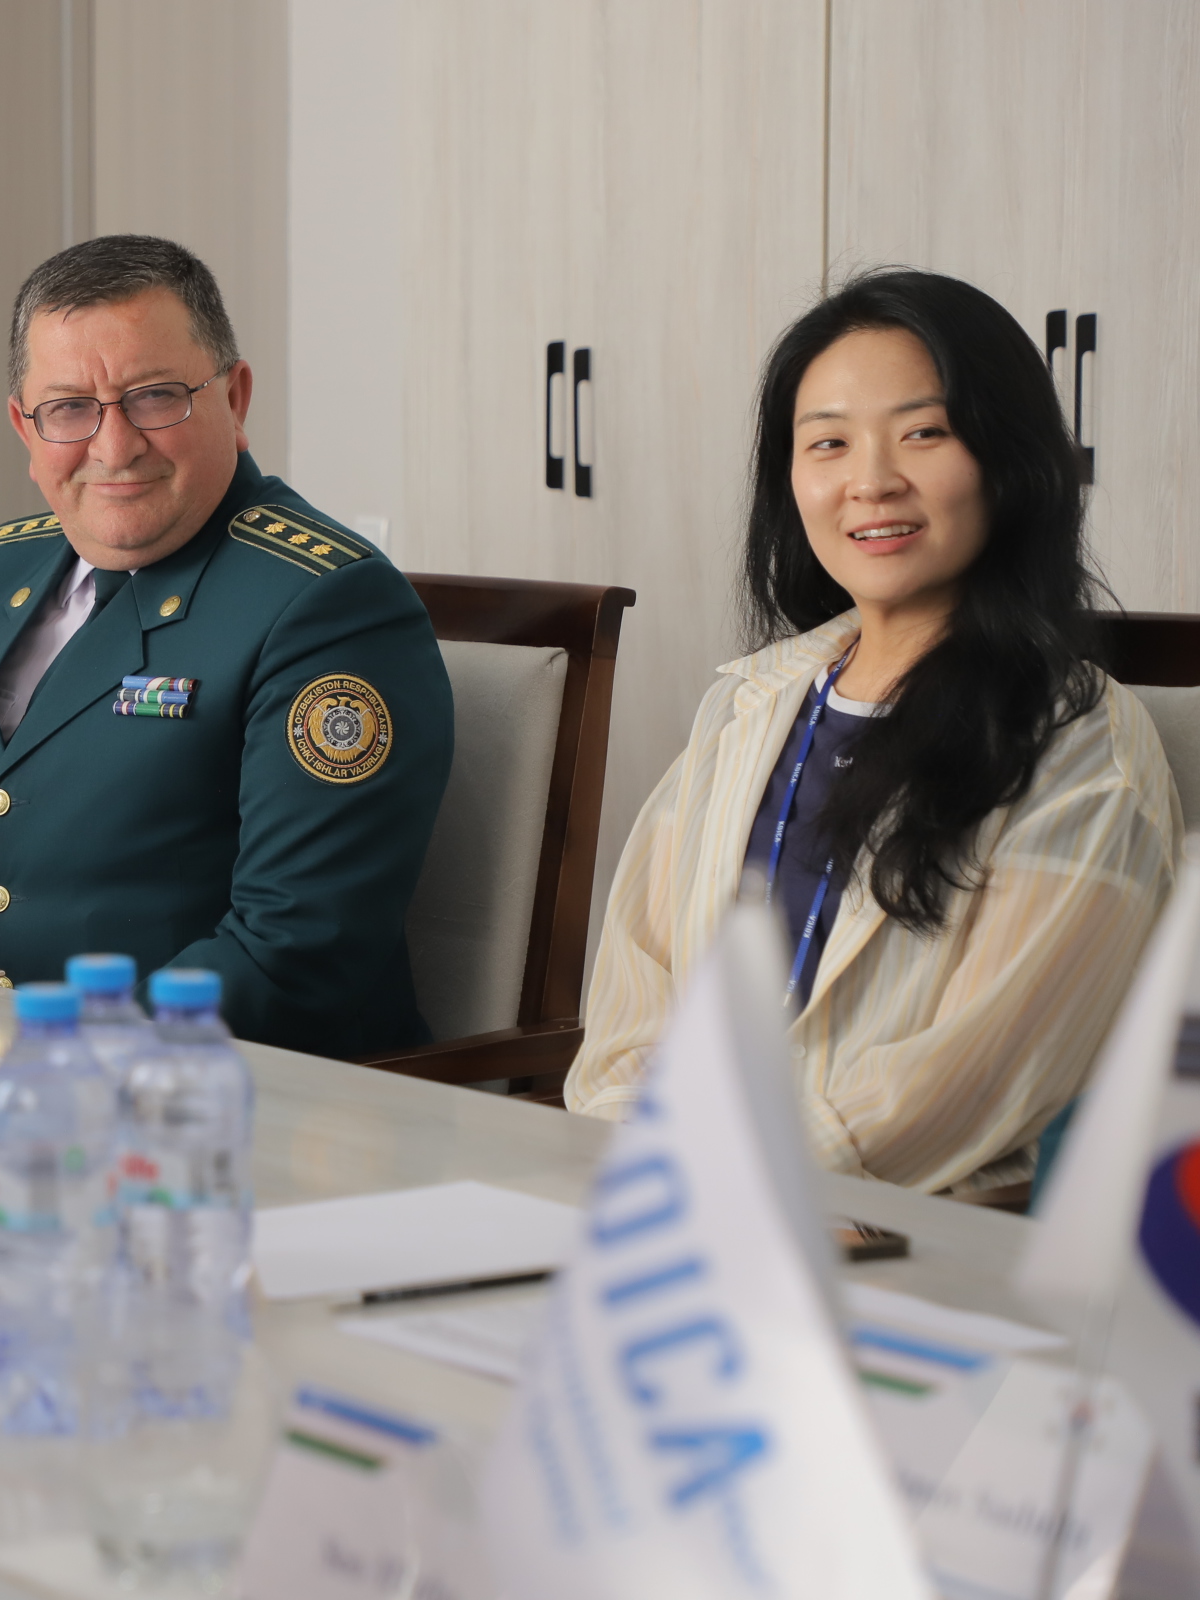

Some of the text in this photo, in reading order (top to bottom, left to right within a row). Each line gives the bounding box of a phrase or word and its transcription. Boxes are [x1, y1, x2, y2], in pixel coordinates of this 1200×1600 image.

[342, 680, 388, 733] RESPUBLIKASI
[808, 705, 822, 728] KOICA
[296, 738, 385, 778] ICHKI ISHLAR VAZIRLIGI
[790, 762, 803, 786] KOICA
[774, 820, 785, 845] KOICA
[803, 911, 817, 939] KOICA
[588, 1085, 770, 1515] OICA
